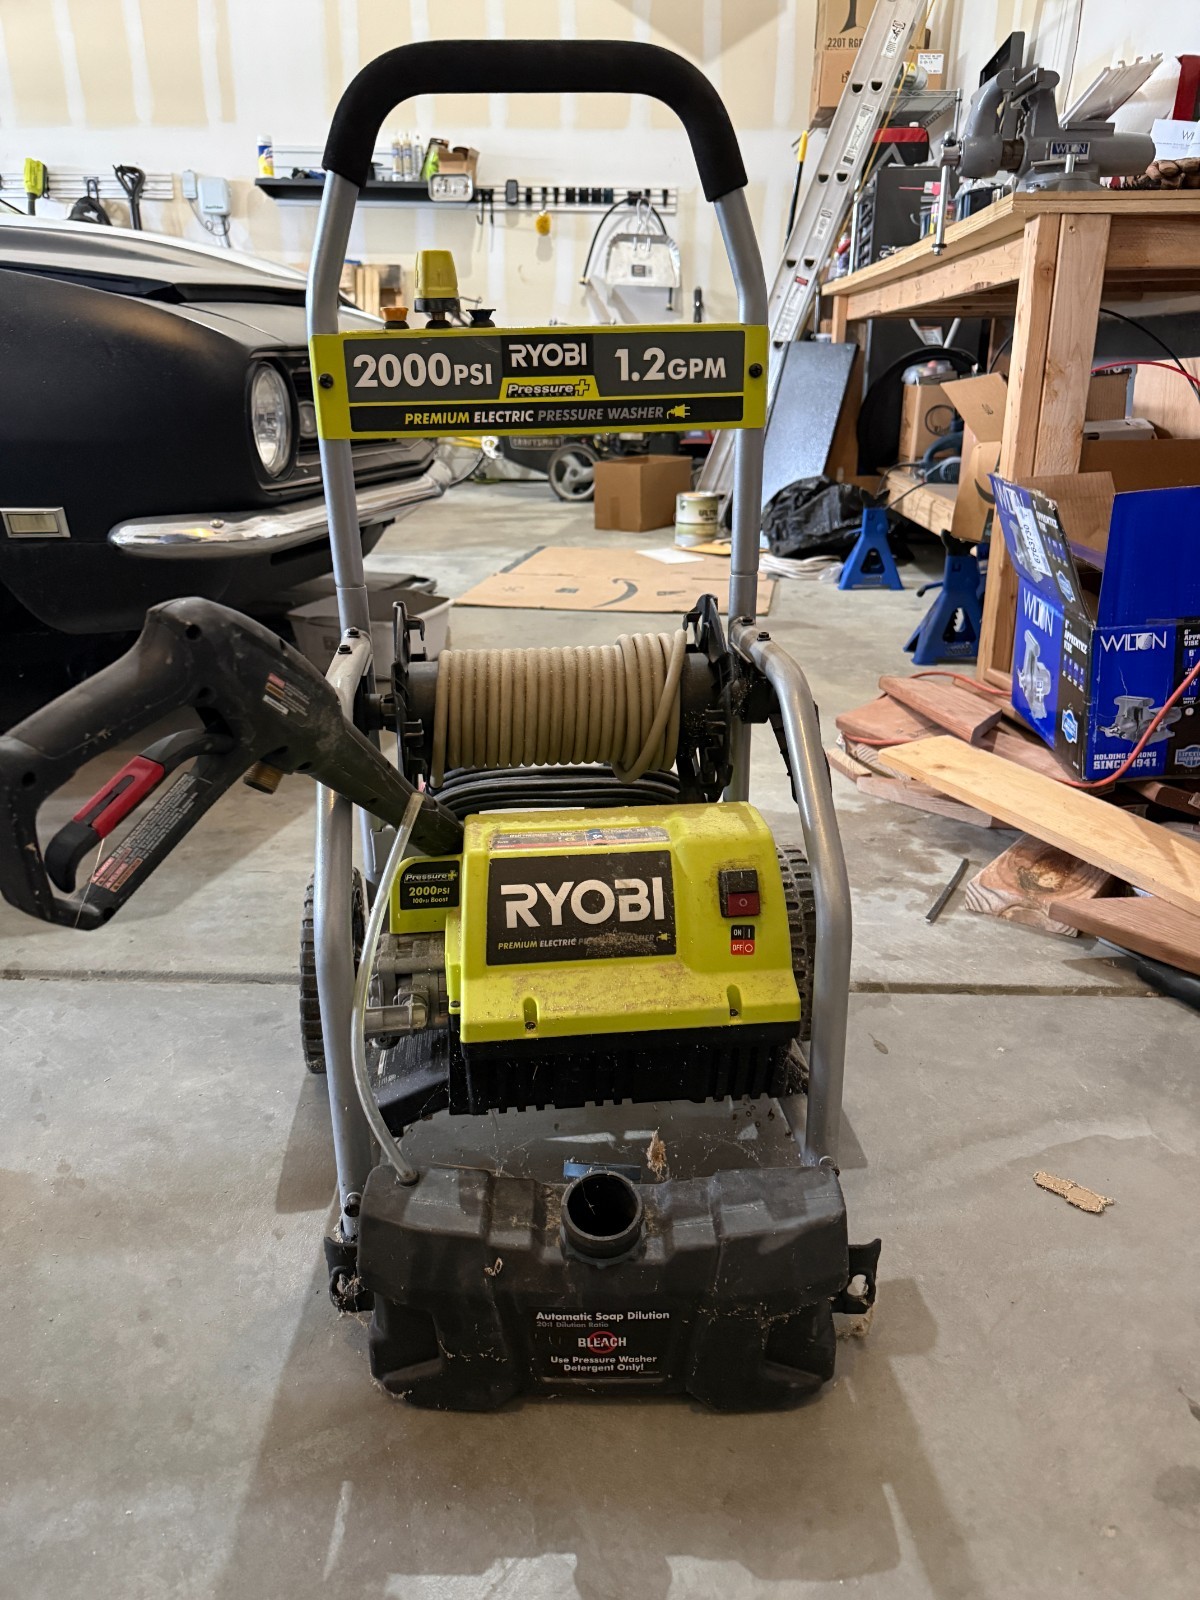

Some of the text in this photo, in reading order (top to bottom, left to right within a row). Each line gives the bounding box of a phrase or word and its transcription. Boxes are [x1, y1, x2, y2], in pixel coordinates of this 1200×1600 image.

[827, 38, 846, 48] 220T
[508, 342, 588, 368] RYOBI
[353, 352, 493, 388] 2000PSI
[614, 347, 727, 382] 1.2GPM
[404, 406, 664, 425] PREMIUM ELECTRIC PRESSURE WASHER
[1100, 631, 1167, 652] WILTON
[1127, 751, 1157, 759] SRONG
[1132, 758, 1157, 768] 1941
[409, 885, 450, 897] 2000PSI
[501, 877, 665, 928] RYOBI
[733, 928, 742, 936] ON
[498, 940, 538, 950] PREMIUM
[540, 939, 576, 948] ELECTRIC
[536, 1311, 670, 1322] Automatic Soap Dilution
[577, 1337, 627, 1348] BLEACH
[550, 1355, 657, 1364] Use Pressure Washer
[563, 1363, 644, 1373] Detergent Only!
